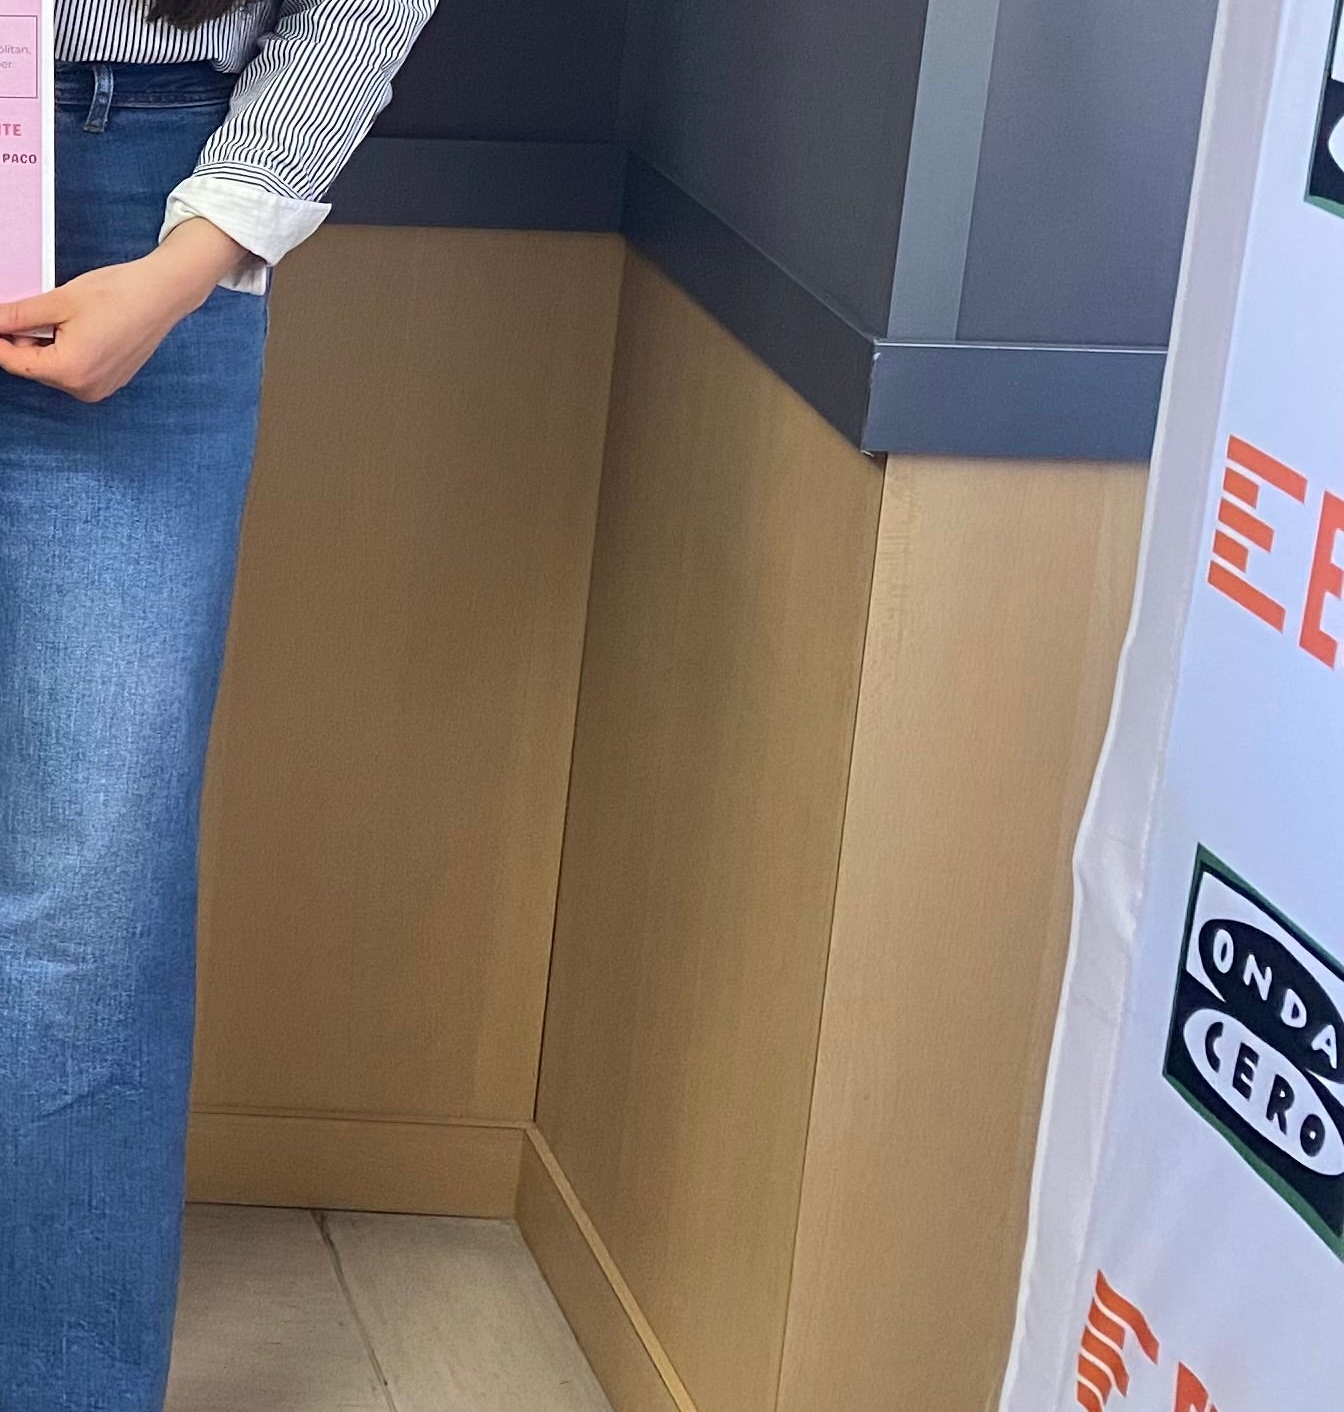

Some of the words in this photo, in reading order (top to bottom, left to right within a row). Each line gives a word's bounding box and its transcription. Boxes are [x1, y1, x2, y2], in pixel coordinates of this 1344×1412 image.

[2, 153, 37, 164] PACO
[1212, 929, 1338, 1069] ONDA
[1204, 1021, 1326, 1157] CERO
